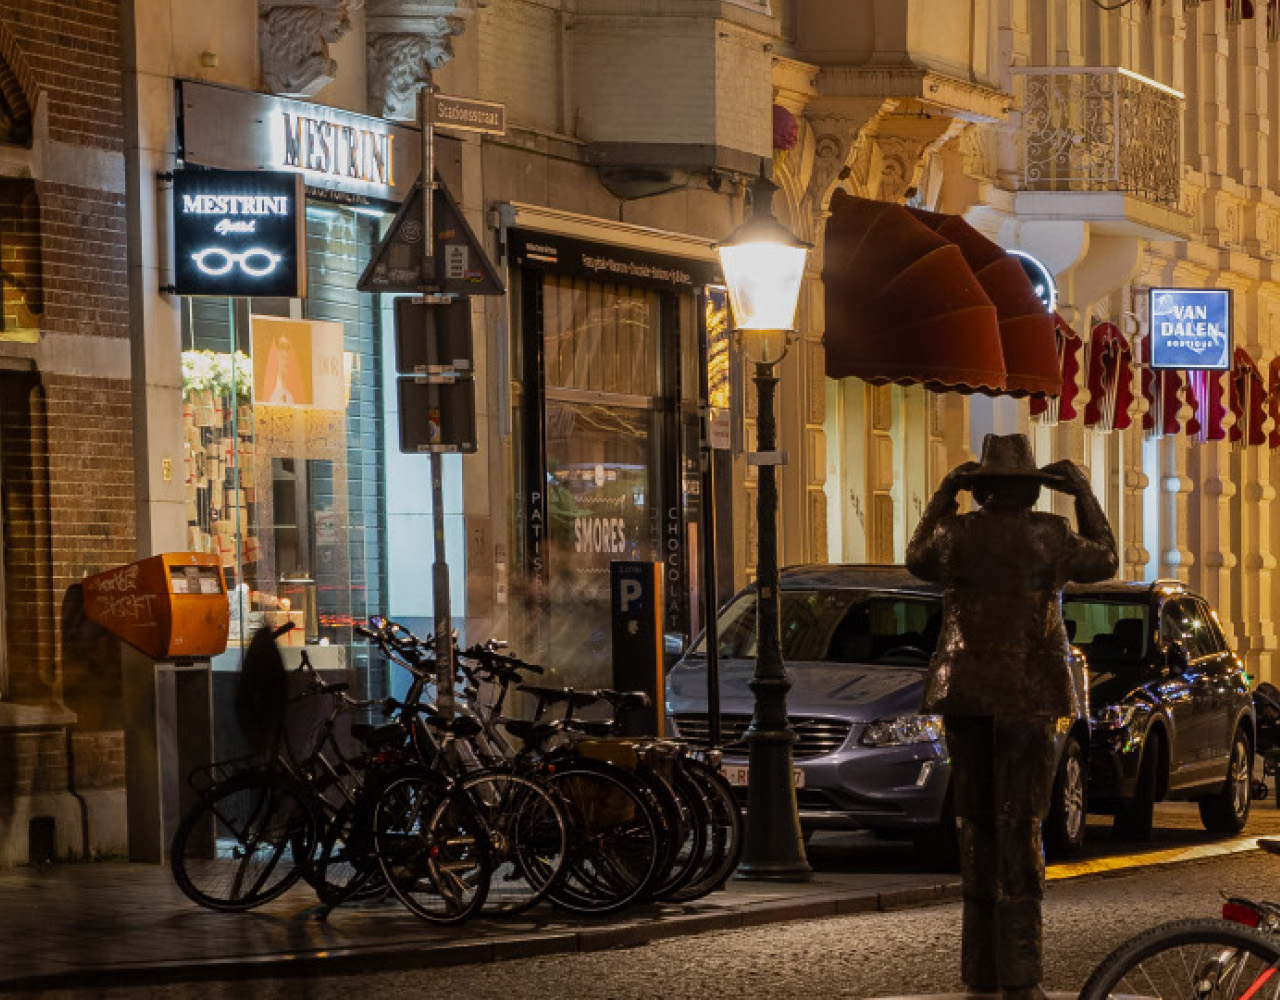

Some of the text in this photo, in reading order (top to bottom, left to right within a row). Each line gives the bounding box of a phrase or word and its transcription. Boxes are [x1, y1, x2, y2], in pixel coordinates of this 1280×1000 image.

[281, 110, 396, 188] MESTRINI
[183, 194, 289, 216] MESTRINI
[1172, 305, 1207, 320] VAN
[1161, 321, 1220, 337] DALEN
[574, 517, 626, 553] SMORES
[620, 579, 643, 612] P
